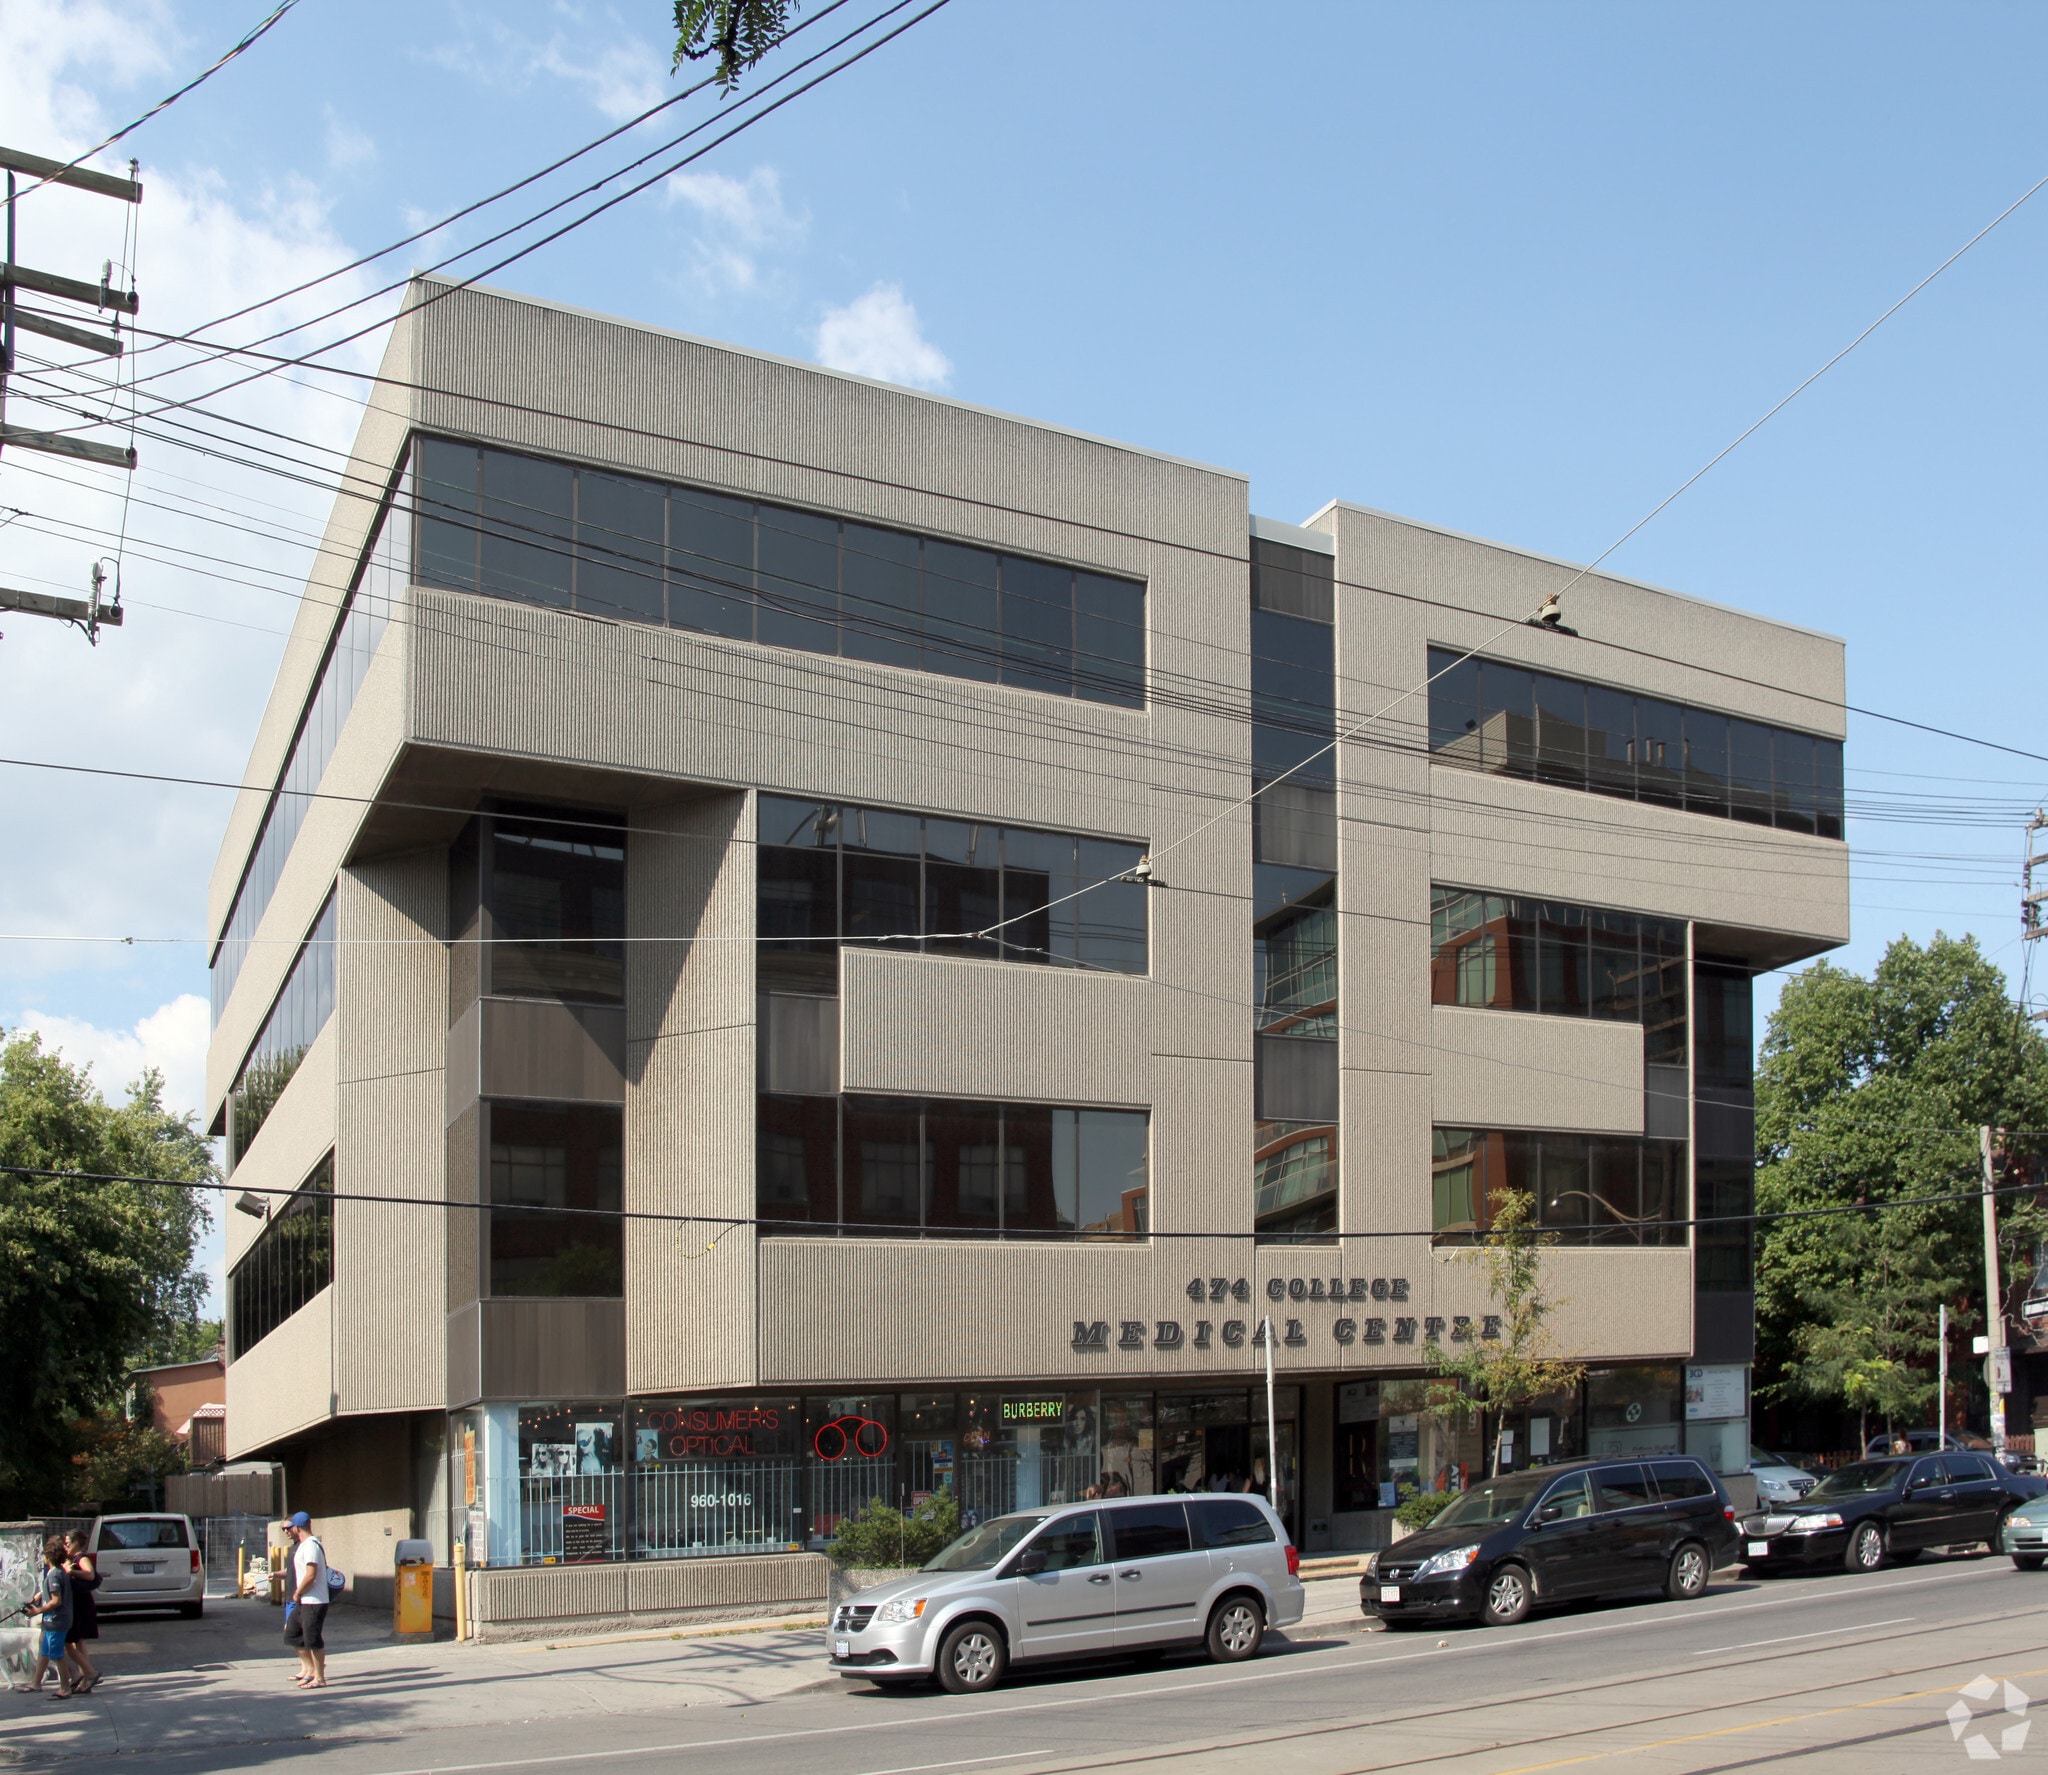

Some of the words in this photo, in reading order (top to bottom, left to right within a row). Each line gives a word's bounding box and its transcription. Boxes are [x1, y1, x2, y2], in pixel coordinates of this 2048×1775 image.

[1186, 1277, 1248, 1298] 474
[1266, 1277, 1408, 1298] COLLEGE
[1070, 1318, 1305, 1346] MEDICAL
[1333, 1314, 1500, 1341] CENTRE
[647, 1408, 779, 1432] CONSUMER'S
[1003, 1401, 1063, 1419] BURBERRY
[669, 1435, 757, 1457] OPTICAL
[567, 1505, 600, 1515] SPECIAL
[690, 1493, 752, 1508] 960-1016
